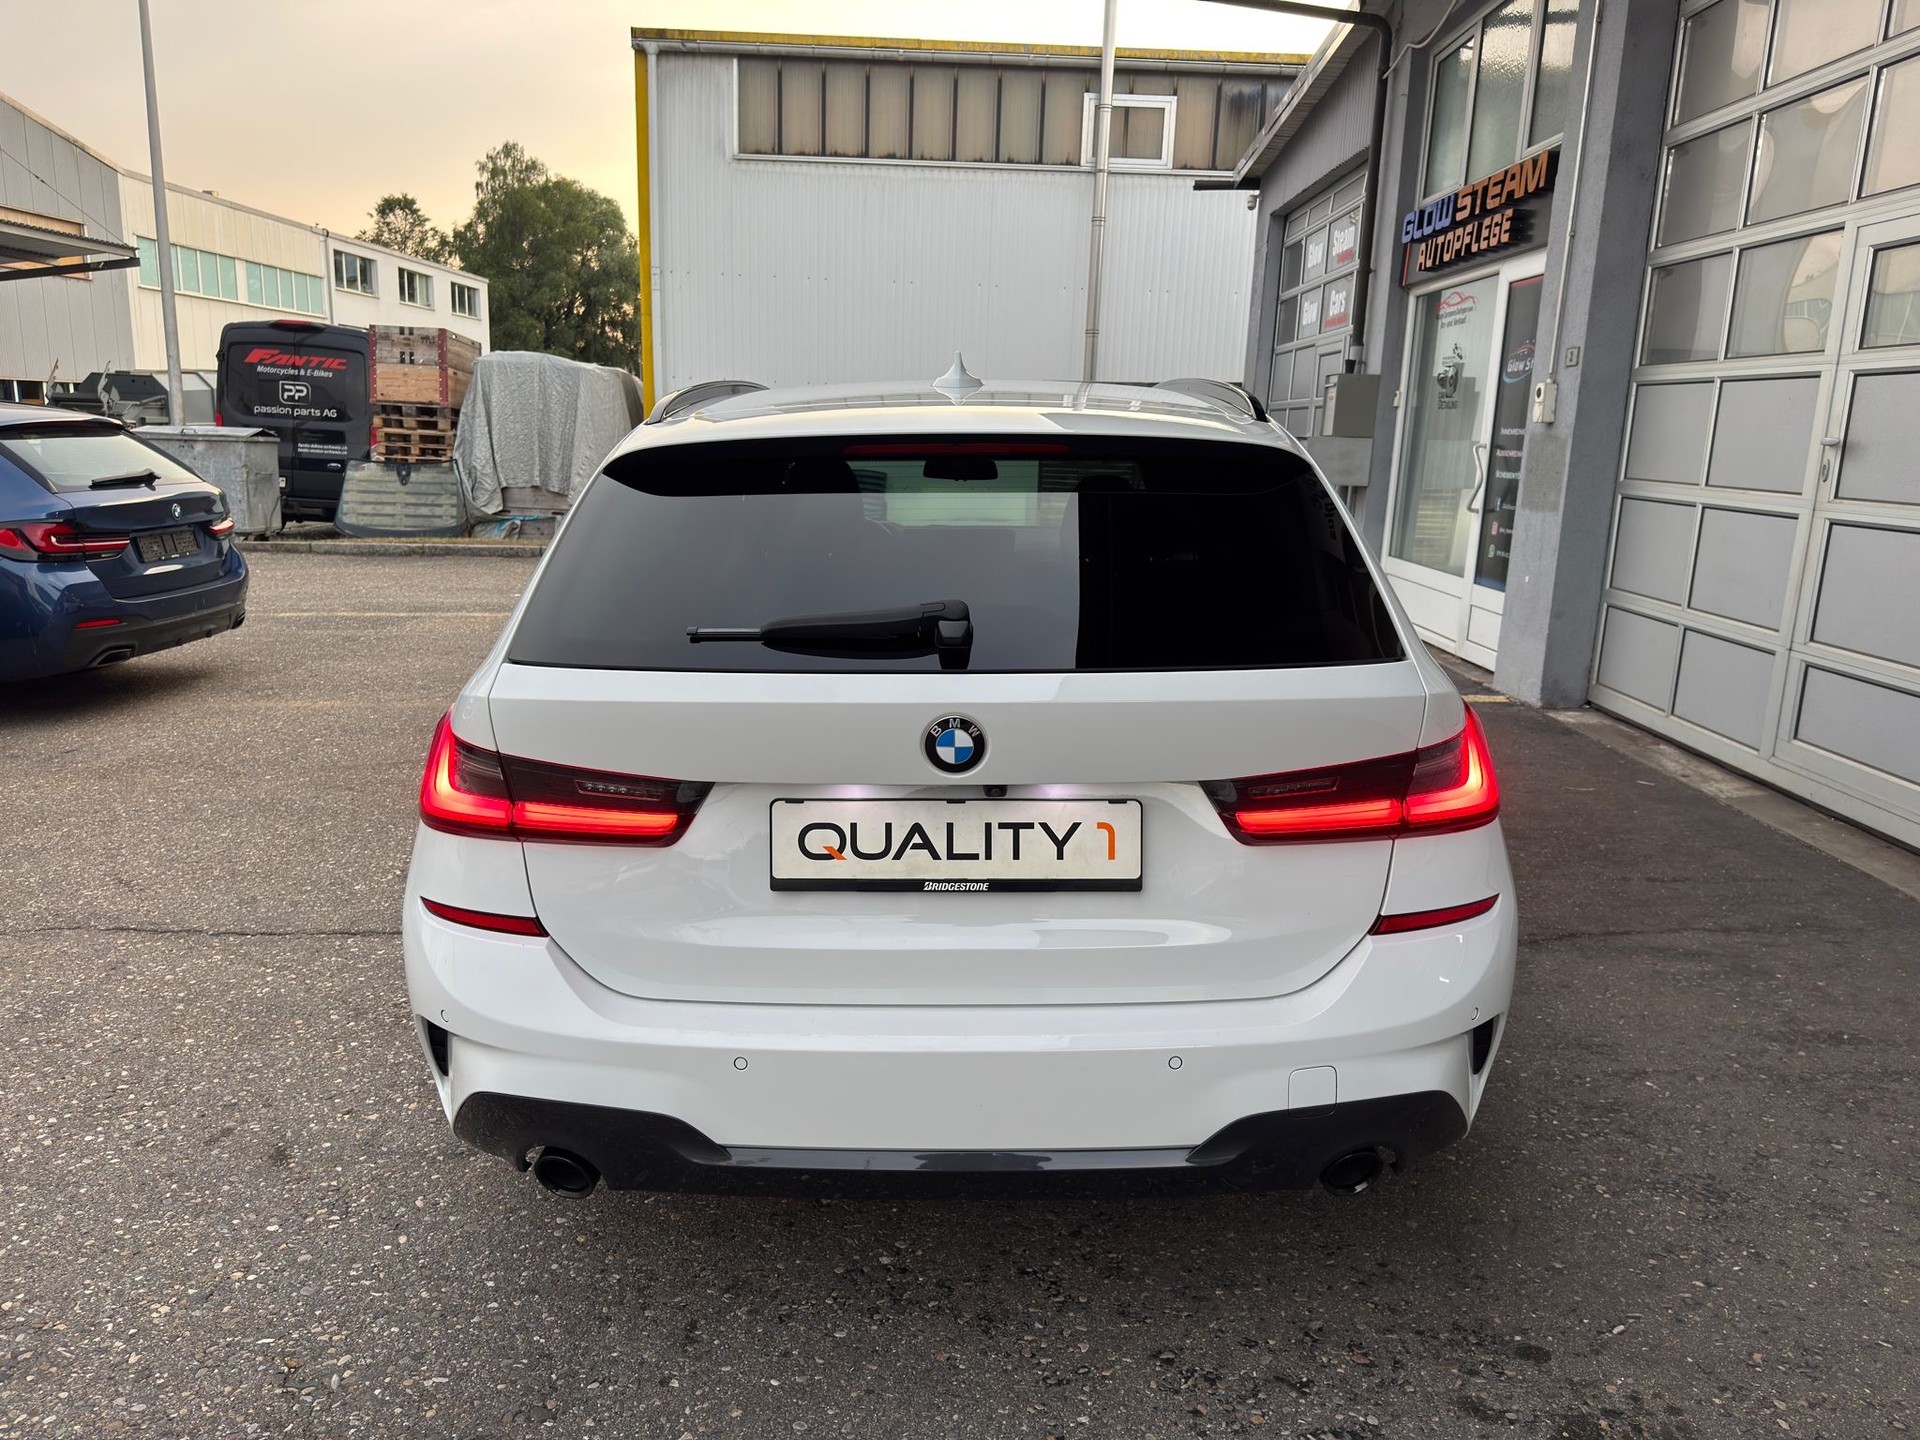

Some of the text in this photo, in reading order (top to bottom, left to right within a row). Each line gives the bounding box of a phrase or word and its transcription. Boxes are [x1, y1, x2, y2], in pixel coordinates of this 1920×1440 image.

[1402, 149, 1549, 244] GLOW STEAM
[1416, 208, 1514, 272] AUTOPFLEGE
[244, 348, 347, 369] FANTIC
[1507, 358, 1525, 373] Glow
[256, 365, 299, 376] Motorcycles
[306, 369, 333, 378] E-Bikes
[283, 385, 308, 401] PP
[254, 405, 338, 418] passion parts AG
[930, 718, 981, 738] BMW
[797, 822, 1116, 861] QUALITY 1
[923, 881, 990, 892] BRIDGESTONE
